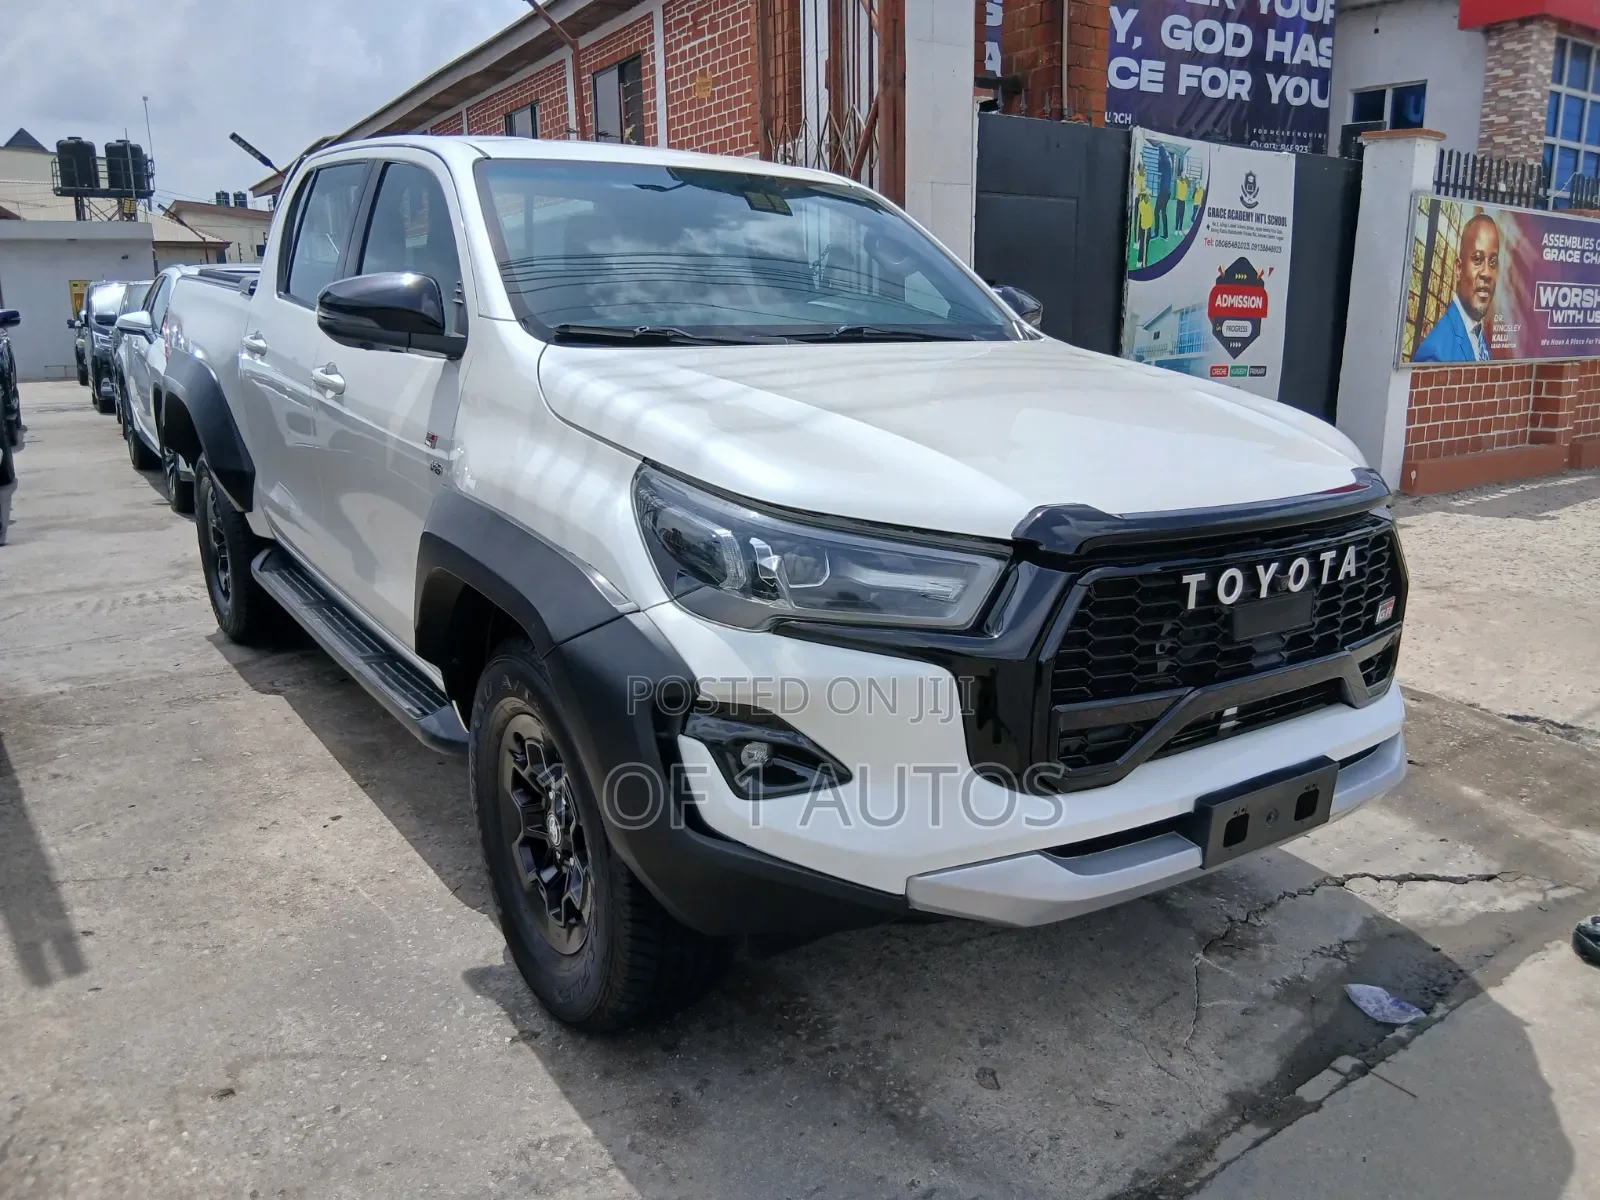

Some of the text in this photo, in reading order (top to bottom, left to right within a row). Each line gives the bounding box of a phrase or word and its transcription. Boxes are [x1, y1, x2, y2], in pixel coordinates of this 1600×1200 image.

[1161, 15, 1252, 58] GOD
[1265, 28, 1333, 68] HAS
[1107, 56, 1330, 109] CE FOR YOU
[1207, 206, 1227, 219] GRACE
[1227, 209, 1254, 223] ACADEMY
[1267, 214, 1288, 227] SCHOOL
[1541, 233, 1595, 251] ASSEMBLIES
[1543, 248, 1580, 263] GRACE
[1215, 294, 1263, 309] ADMISSION
[1539, 285, 1600, 309] WORSH
[1552, 309, 1584, 324] WITH
[1492, 324, 1522, 332] KINGSLEY
[1491, 333, 1509, 342] KALU
[1181, 545, 1356, 610] TOYOTA
